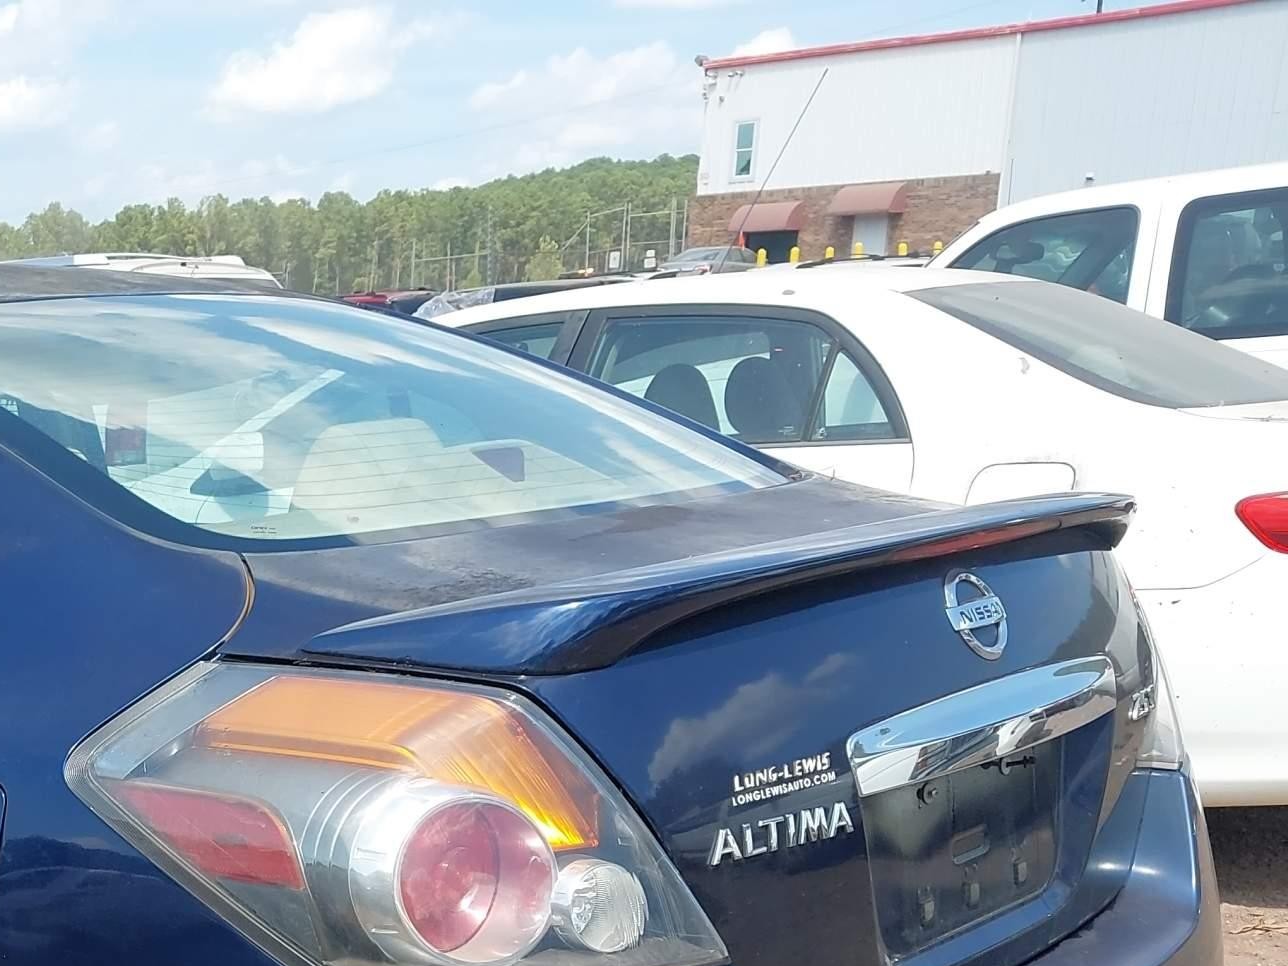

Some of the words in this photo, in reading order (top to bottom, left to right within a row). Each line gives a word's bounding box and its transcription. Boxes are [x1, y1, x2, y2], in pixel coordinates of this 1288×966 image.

[732, 771, 837, 807] LONGLEWISAUTO.COM
[733, 752, 831, 792] LONG-LEWIS
[707, 801, 854, 866] ALTIMA
